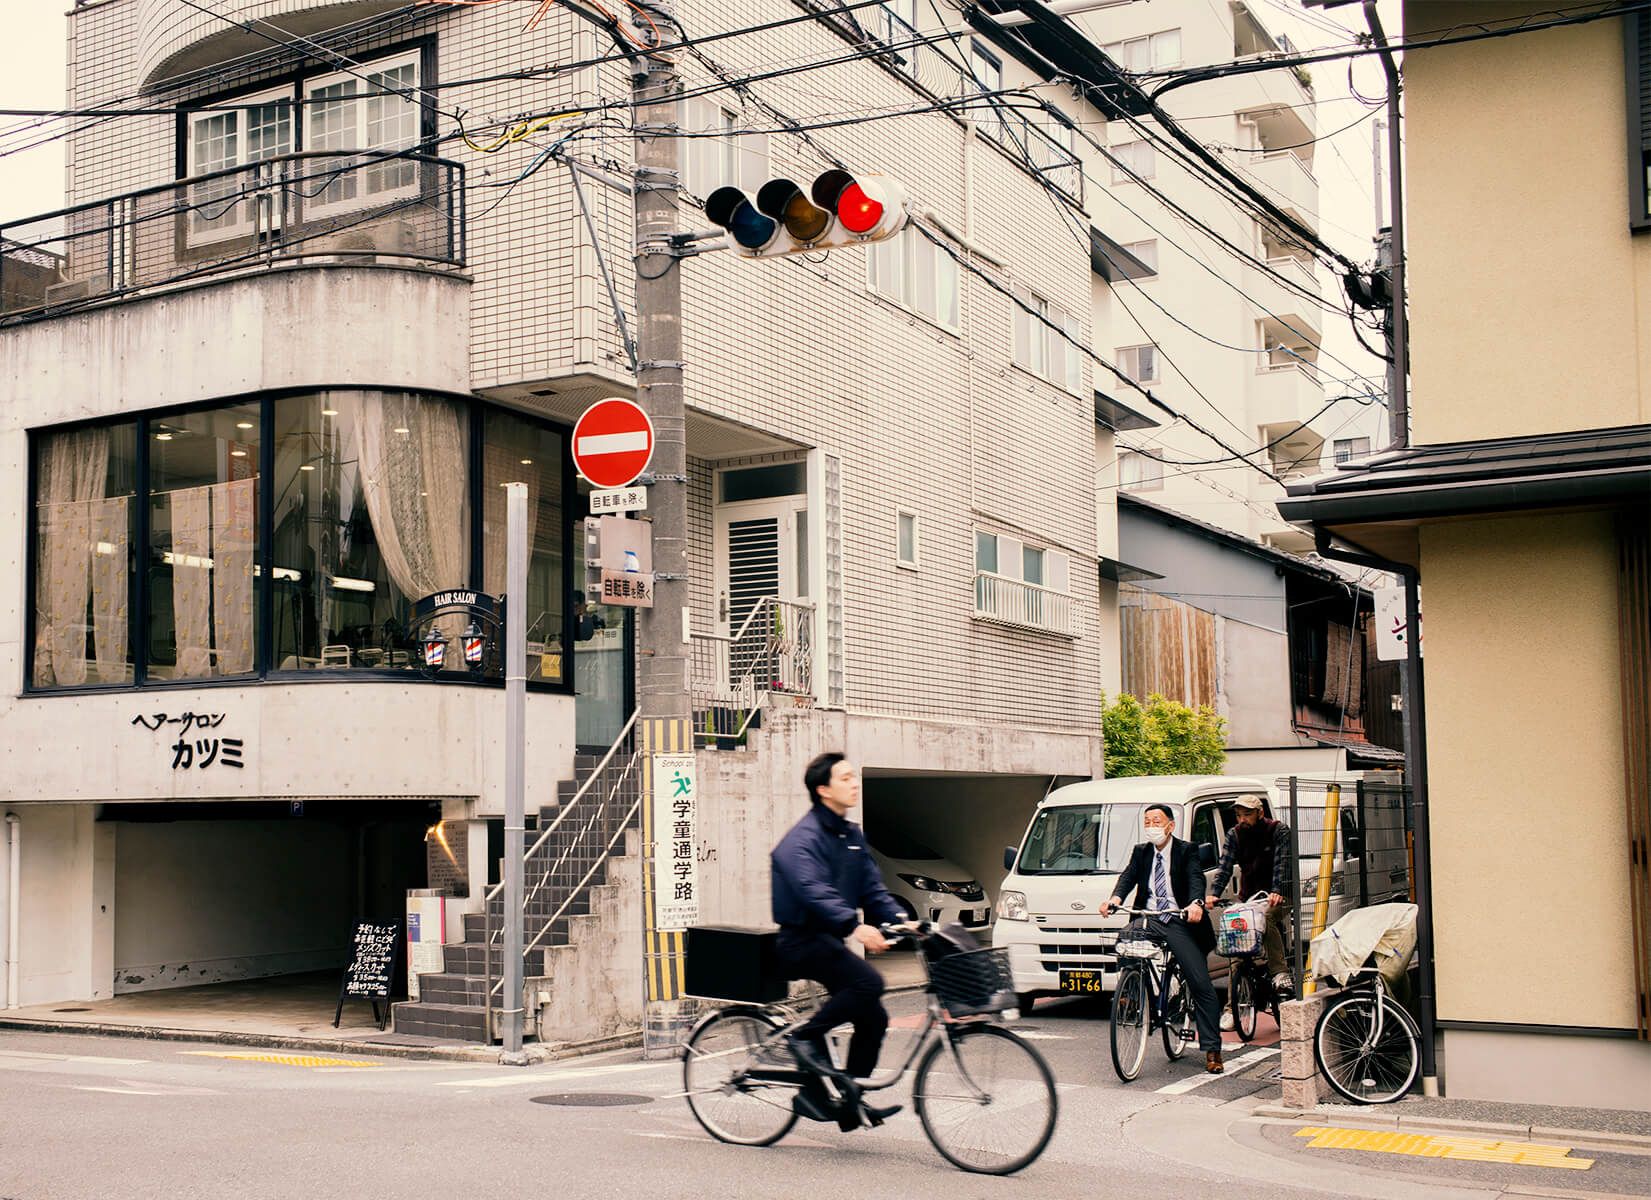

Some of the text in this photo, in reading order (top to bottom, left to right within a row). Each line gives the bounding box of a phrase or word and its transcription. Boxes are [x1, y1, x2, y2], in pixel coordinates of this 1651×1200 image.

[593, 492, 644, 509] 自転車を除く
[434, 590, 477, 607] HAIR SALON
[131, 712, 226, 737] ヘアーサロン
[171, 738, 245, 770] カツミ
[672, 799, 693, 901] 学童通学路
[1069, 979, 1100, 991] 31-66
